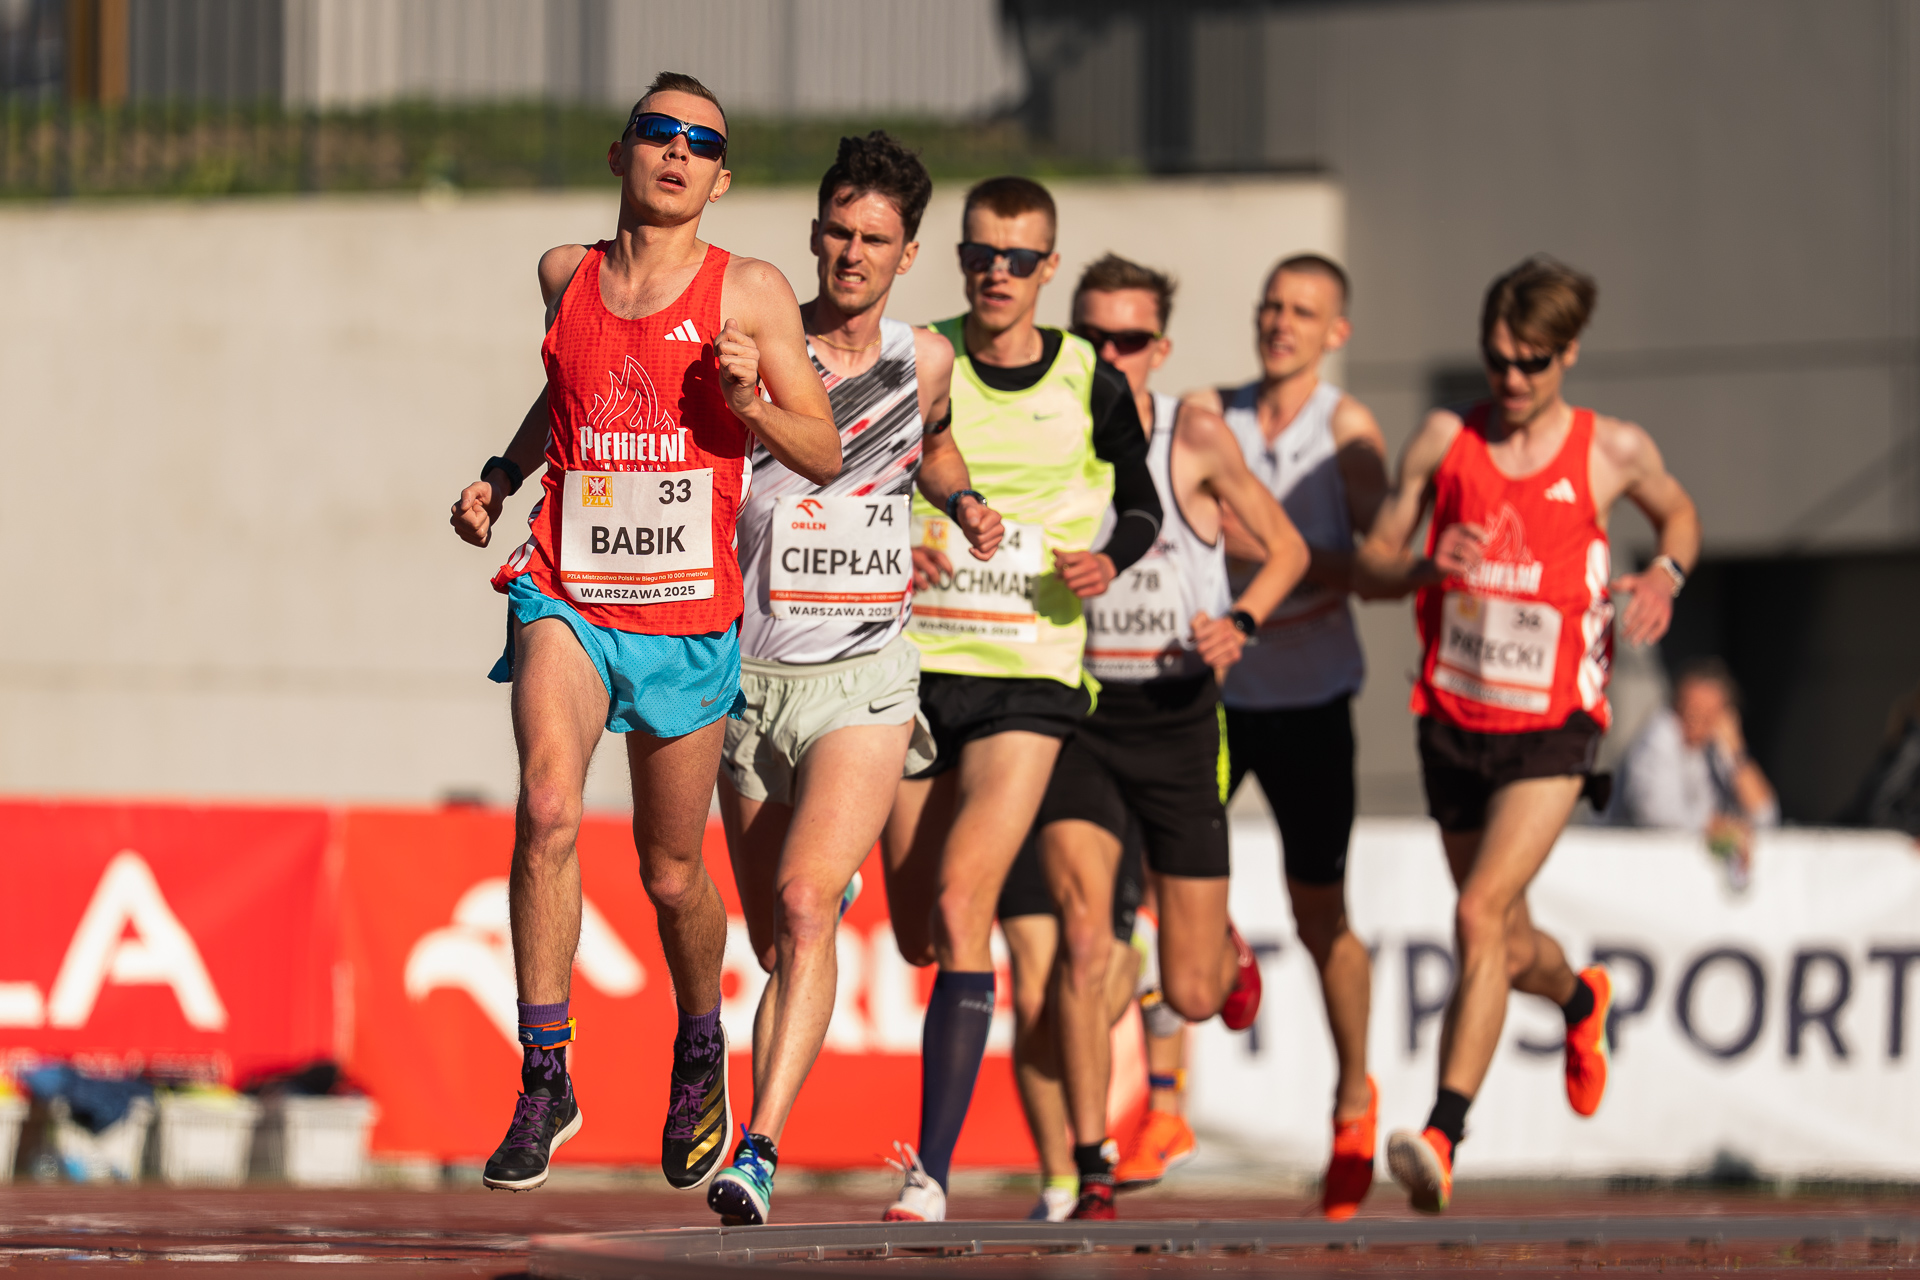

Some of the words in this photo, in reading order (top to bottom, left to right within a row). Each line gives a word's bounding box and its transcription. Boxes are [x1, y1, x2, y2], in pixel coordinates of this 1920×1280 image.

[578, 425, 689, 463] PIEKIELNI
[604, 462, 662, 472] WRSZAWA
[658, 478, 692, 505] 33
[791, 521, 827, 531] ORLEN
[865, 504, 894, 528] 74
[591, 525, 686, 556] BABIK
[998, 528, 1021, 550] 4
[782, 547, 902, 575] CIEPŁAK
[641, 575, 658, 583] Biegu
[1130, 569, 1160, 593] 78
[580, 587, 662, 600] WARSZAWA
[664, 585, 696, 597] 2025
[788, 605, 865, 617] WARSZAWA
[867, 606, 894, 617] 2025
[1516, 945, 1920, 1060] PORT
